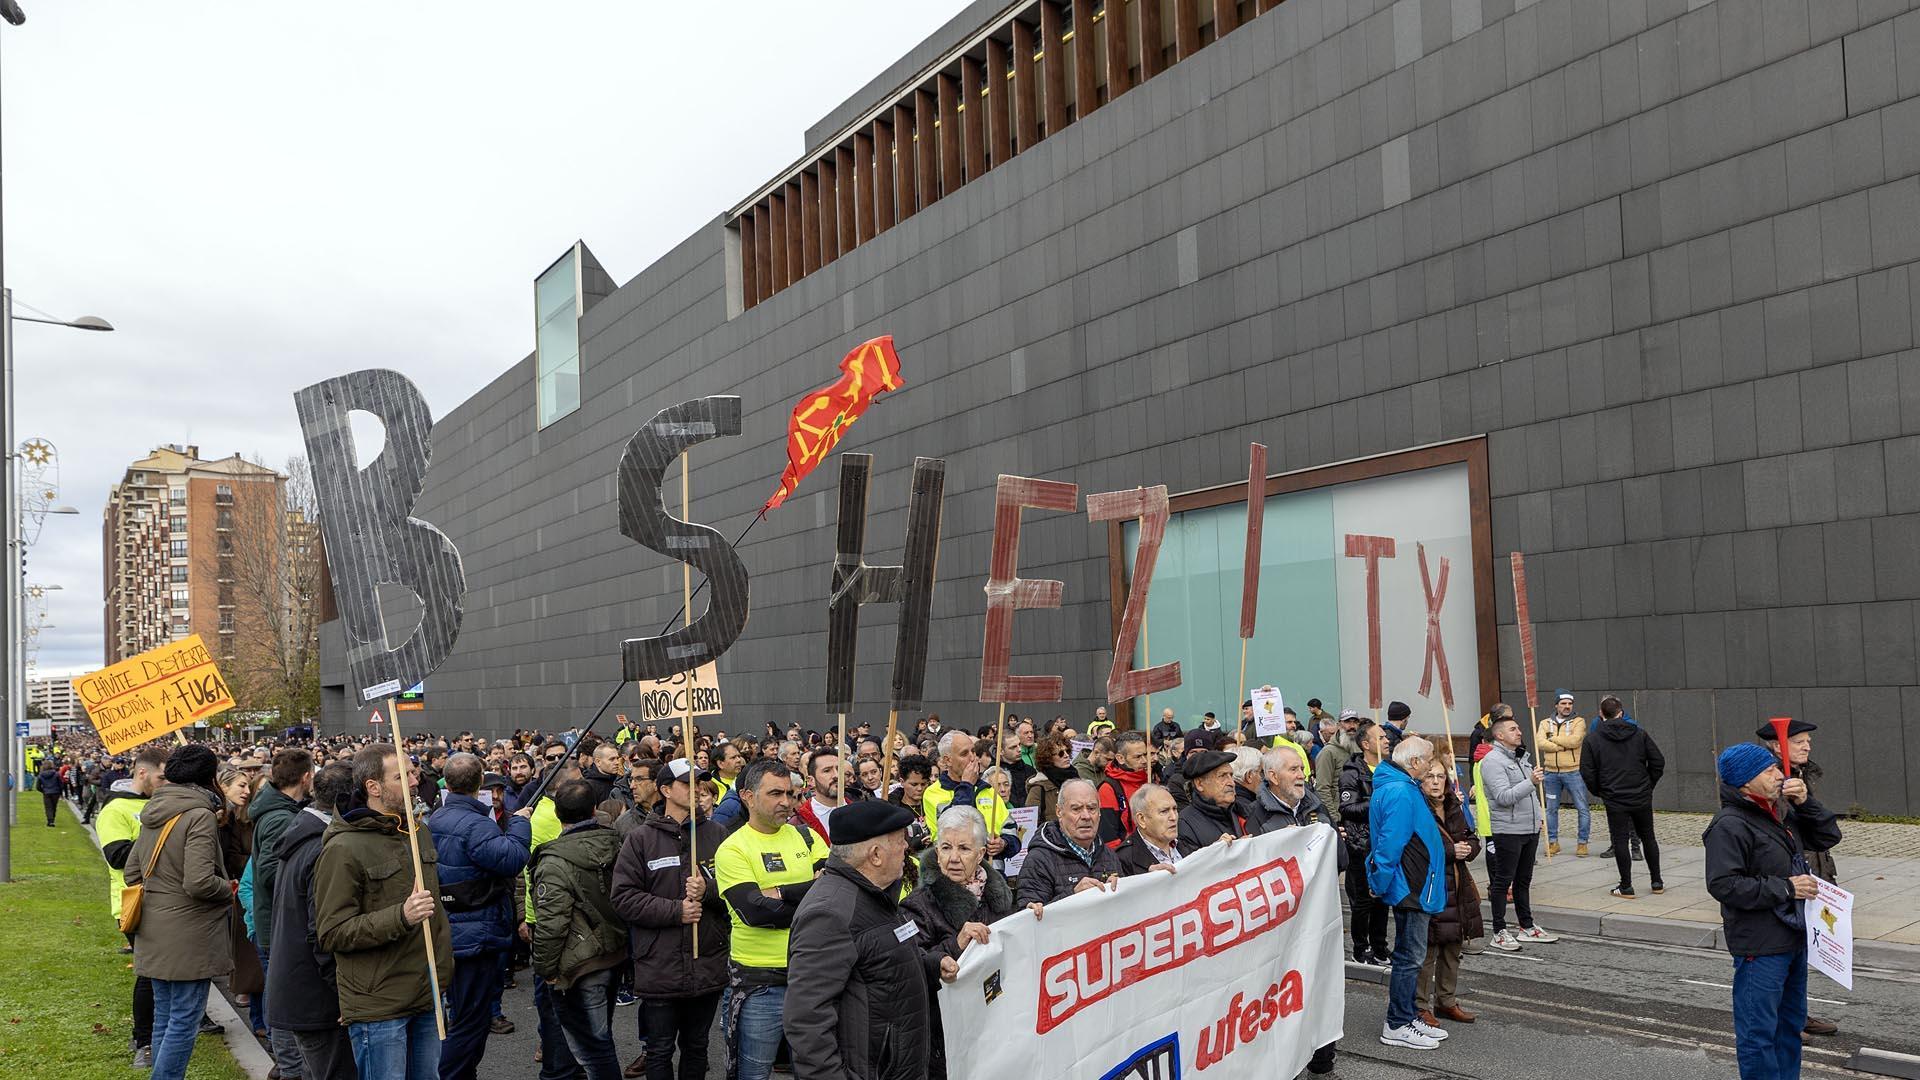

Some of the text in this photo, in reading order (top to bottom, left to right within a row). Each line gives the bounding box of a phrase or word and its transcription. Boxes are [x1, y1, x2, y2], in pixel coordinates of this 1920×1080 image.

[80, 644, 211, 704] CHIVITE DESPIERTA
[92, 672, 230, 731] INDUSTRIA A FUGA
[105, 706, 184, 747] NAVARRA LA
[642, 689, 673, 720] NO
[1195, 969, 1304, 1071] ufesa
